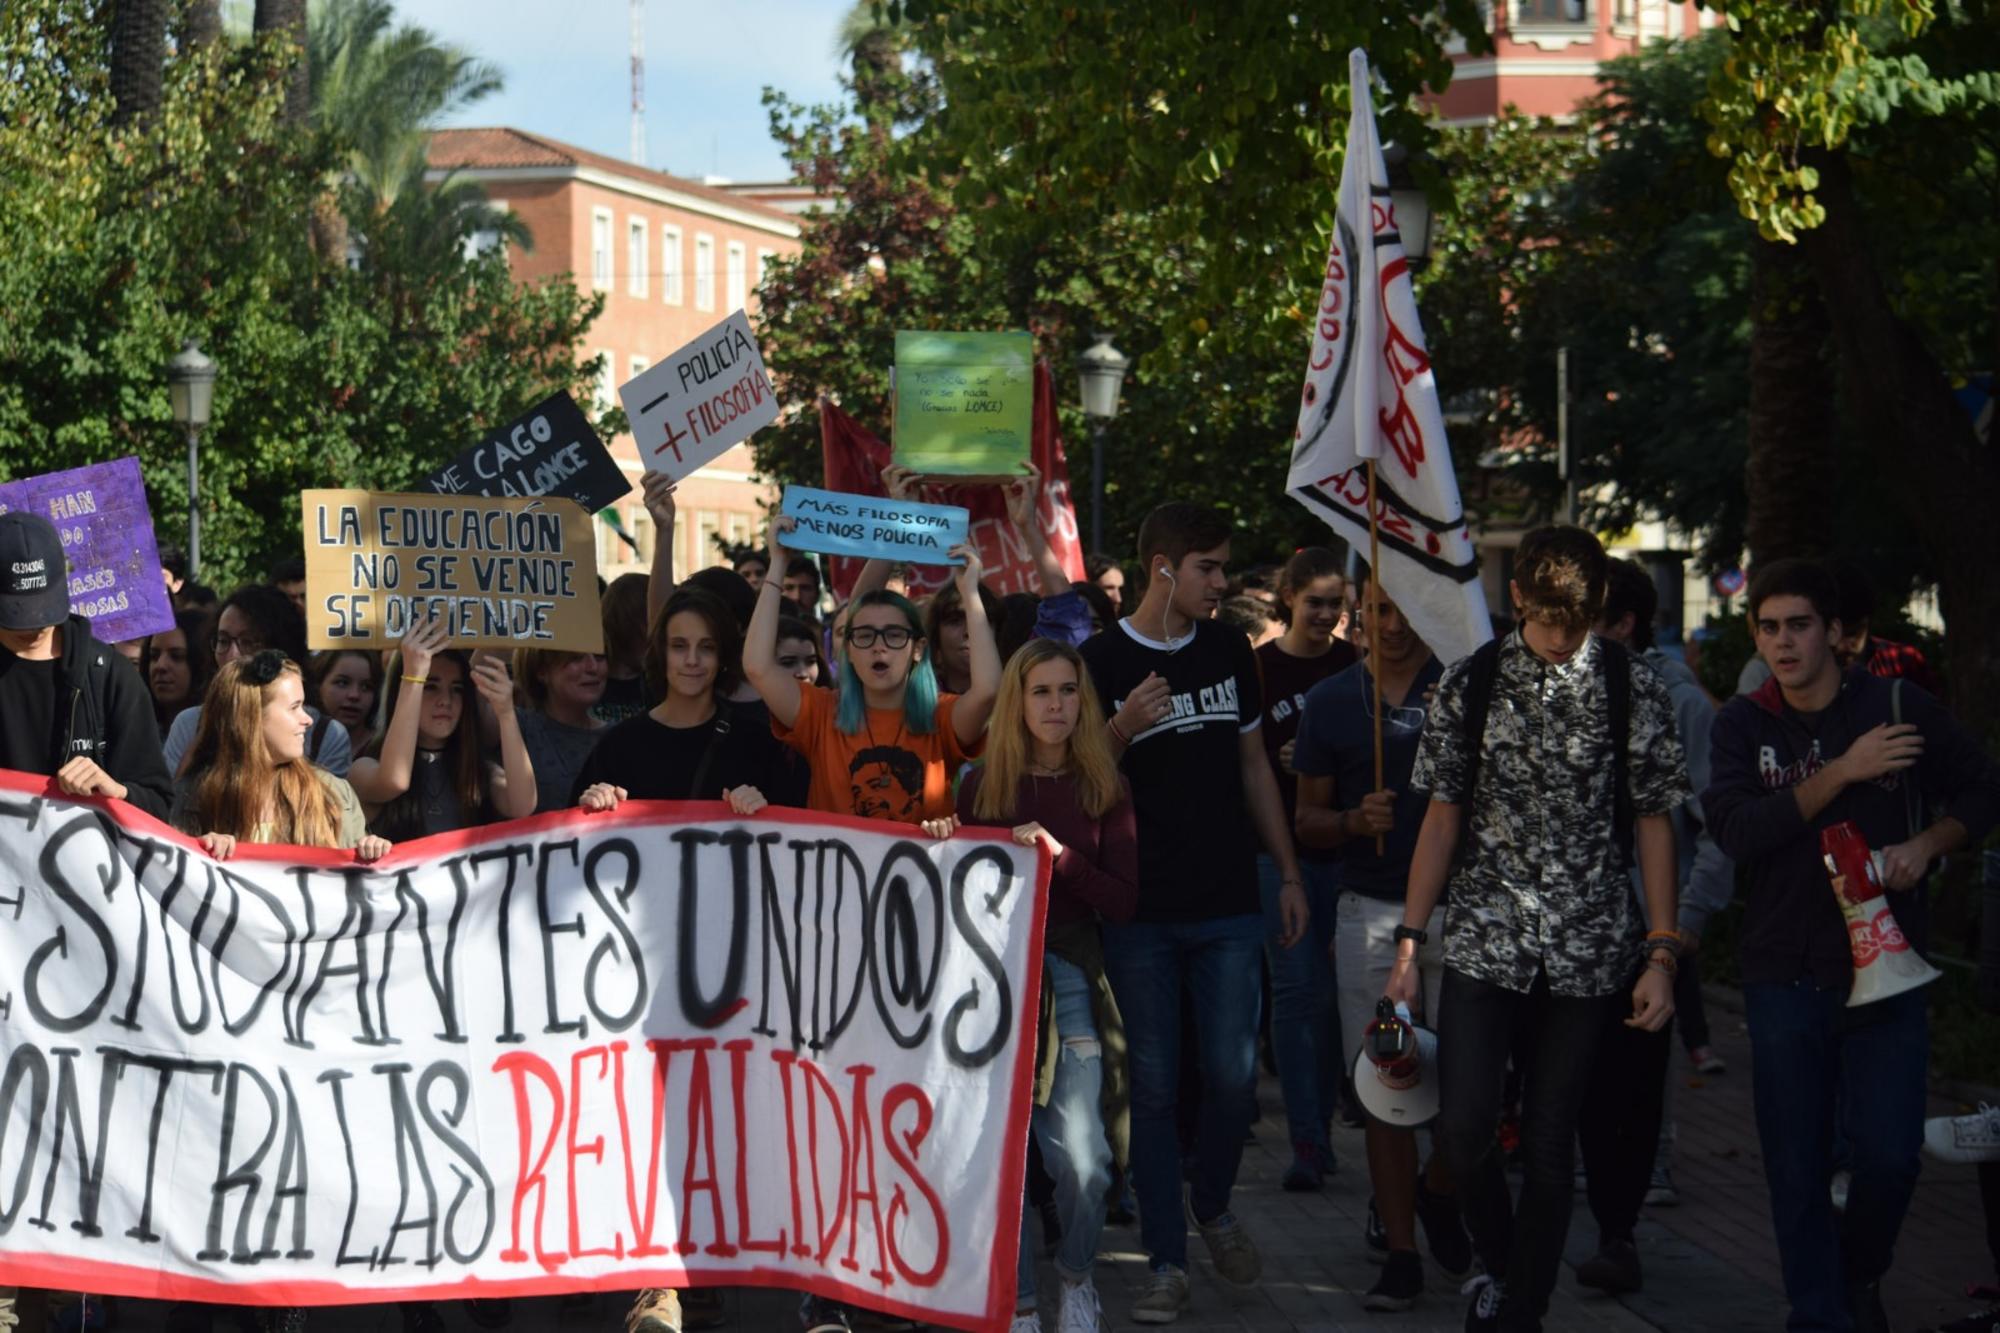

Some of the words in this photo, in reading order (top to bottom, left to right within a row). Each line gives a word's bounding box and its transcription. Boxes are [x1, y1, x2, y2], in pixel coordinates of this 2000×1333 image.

[677, 324, 752, 394] POLICÍA
[686, 360, 772, 444] FILOSOFÍA
[431, 464, 469, 495] ME
[474, 415, 551, 479] CAGO
[517, 441, 589, 497] LOMCE
[318, 504, 363, 546] LA
[379, 501, 562, 554] EDUCACIÓN
[794, 517, 865, 540] MENOS
[858, 507, 950, 530] FILOSOFIA
[352, 552, 399, 589] NO
[416, 555, 459, 591] SE
[472, 557, 576, 597] VENDE
[326, 593, 371, 638] SE
[385, 593, 555, 640] DEFIENDE
[671, 827, 1015, 1069] UNID@S
[317, 1060, 496, 1271] LAS
[492, 1039, 951, 1288] REVALIDAS
